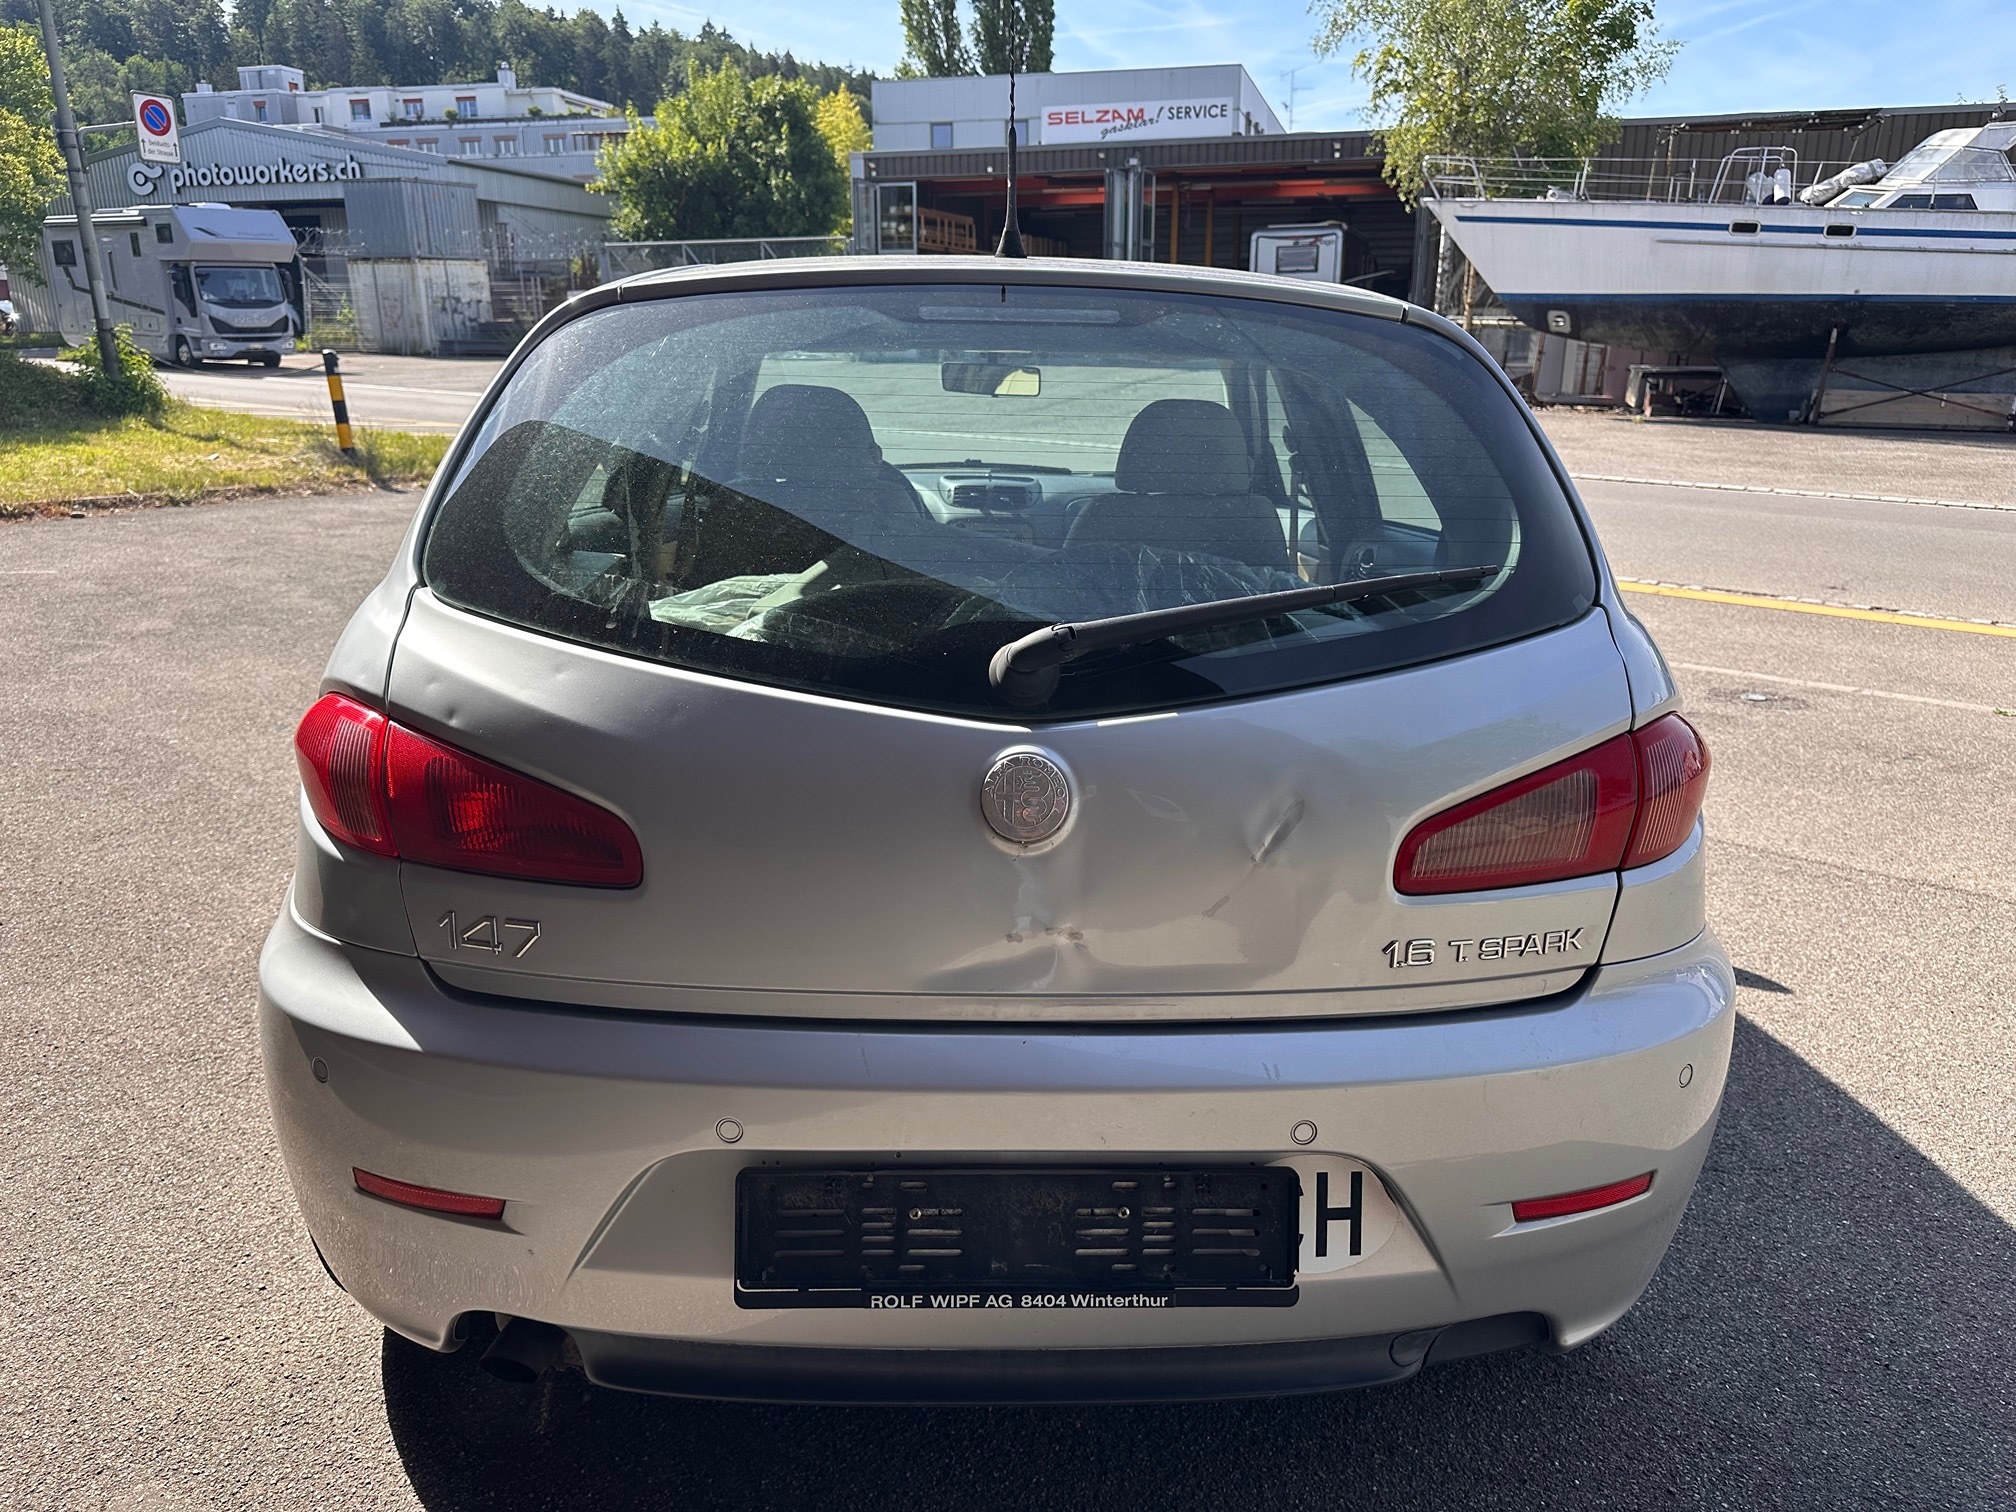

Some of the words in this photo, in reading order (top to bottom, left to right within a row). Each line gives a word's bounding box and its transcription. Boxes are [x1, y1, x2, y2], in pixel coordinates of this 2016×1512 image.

[1047, 108, 1144, 126] SELZAM
[1167, 104, 1228, 120] SERVICE
[170, 154, 361, 195] photoworkers.ch
[985, 760, 1015, 798] ALFA
[1020, 756, 1066, 800] ROMEO
[438, 910, 541, 958] 147
[1479, 927, 1584, 960] SPARK
[870, 1295, 923, 1308] ROLF
[930, 1294, 980, 1308] WIPF
[985, 1294, 1013, 1308] AG
[1021, 1294, 1067, 1308] 8404
[1070, 1293, 1168, 1307] Winterthur
